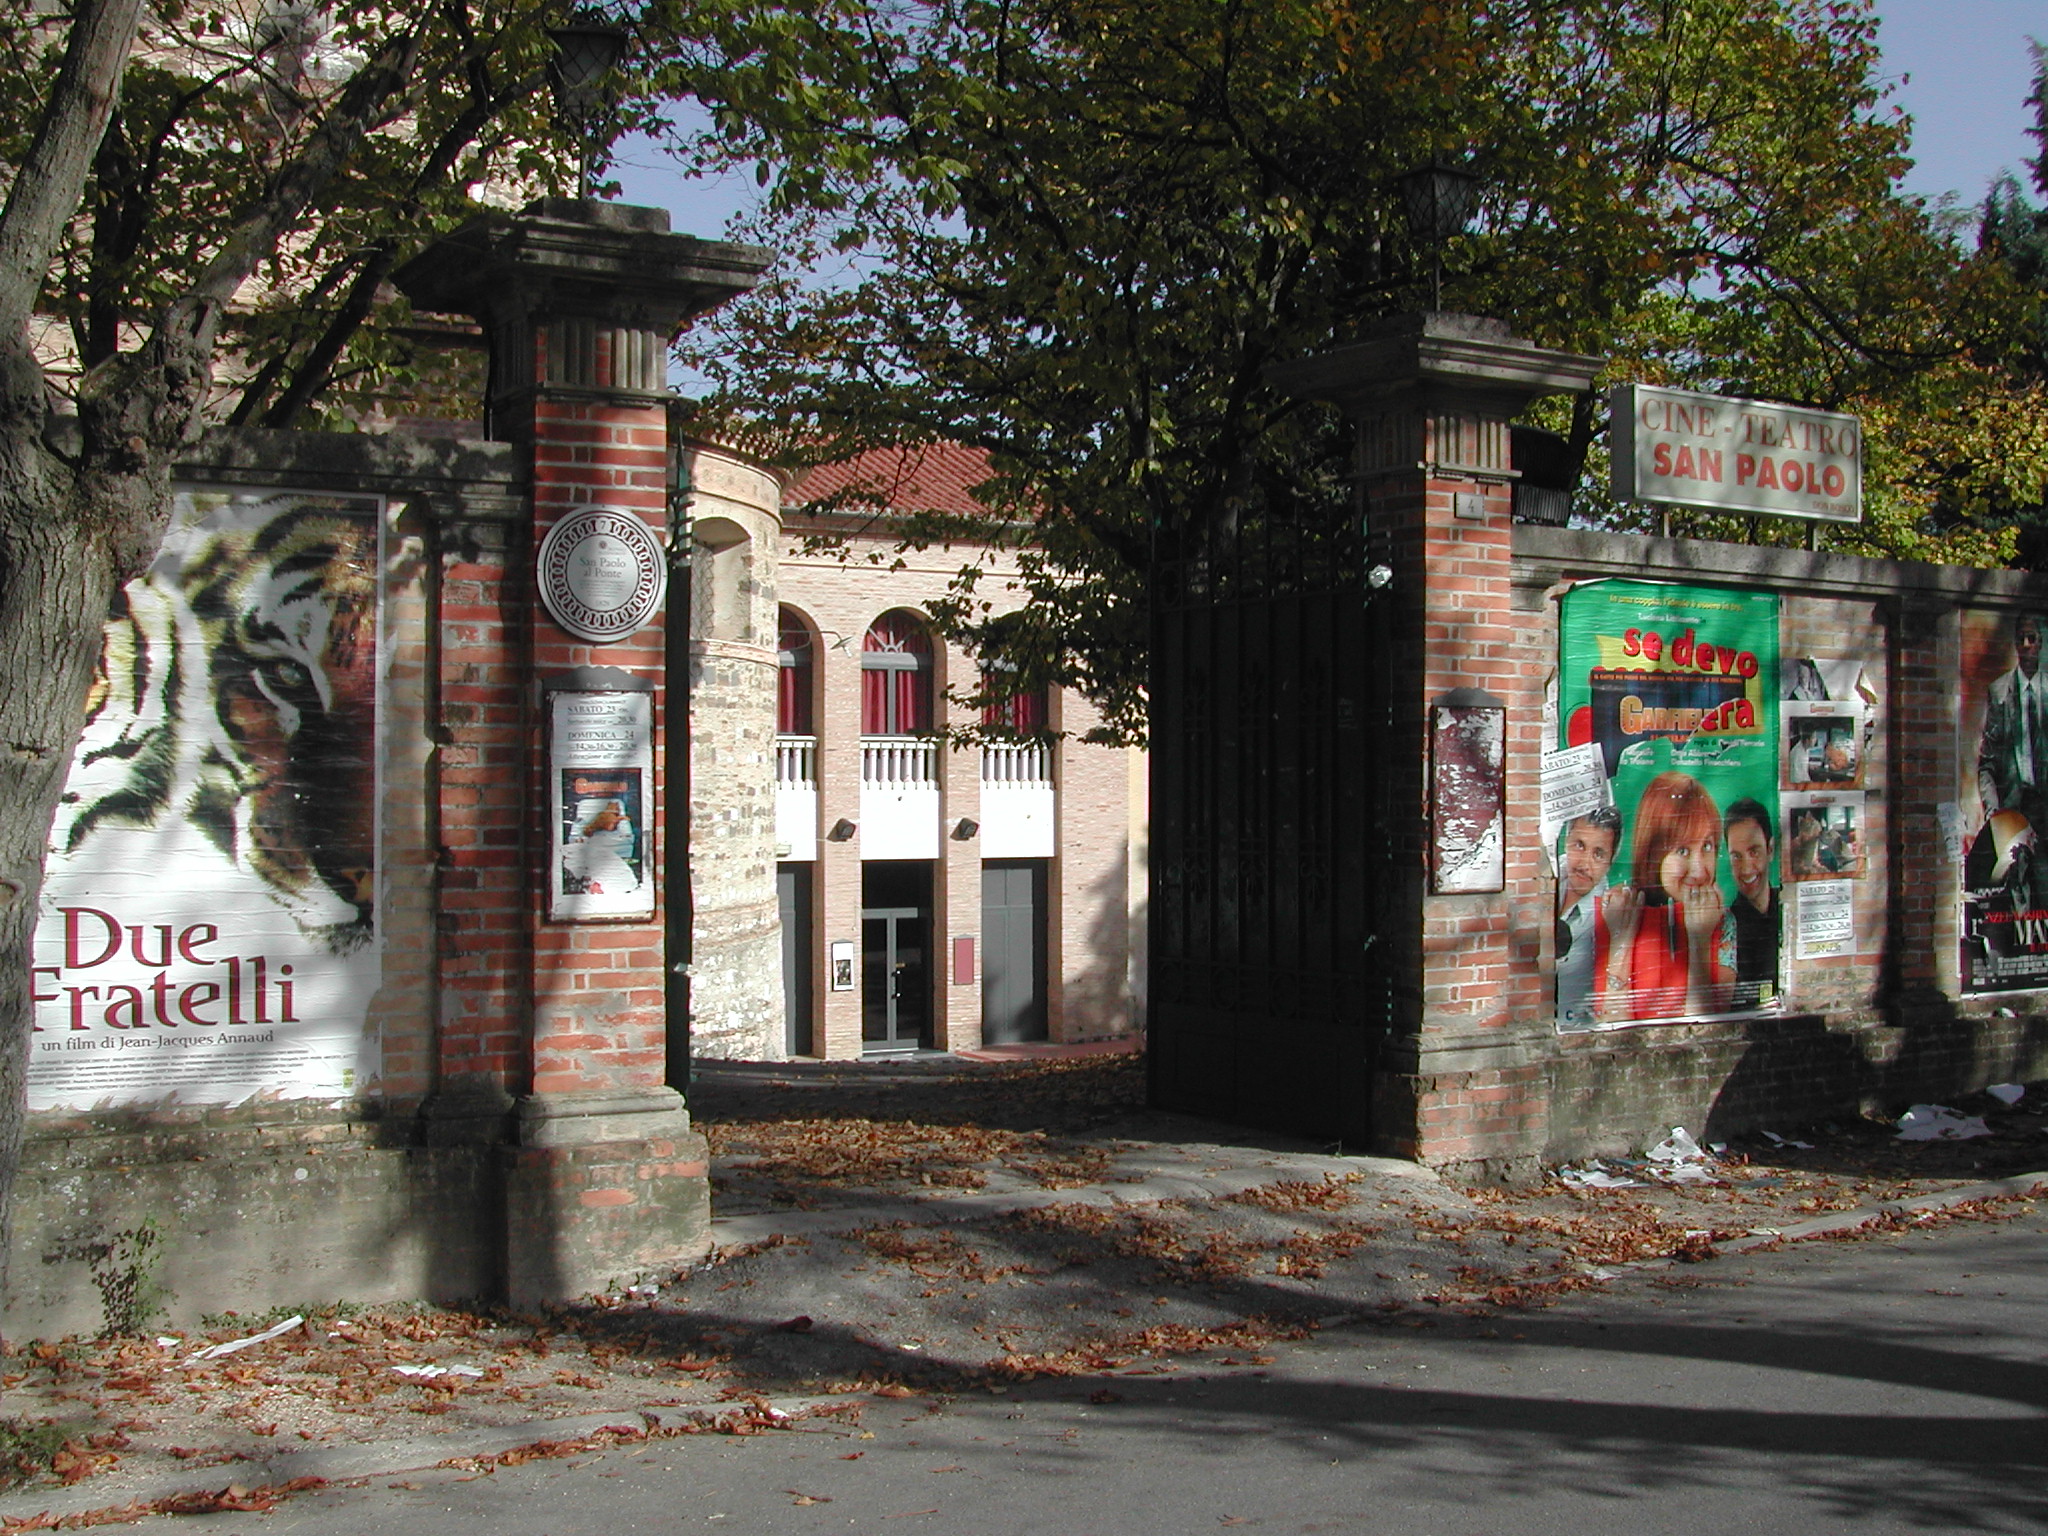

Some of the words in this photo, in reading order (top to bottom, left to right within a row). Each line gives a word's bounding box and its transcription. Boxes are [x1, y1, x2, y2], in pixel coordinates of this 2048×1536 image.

[1641, 398, 1715, 437] CINE
[1740, 412, 1856, 458] TEATRO
[1654, 442, 1723, 483] SAN
[1736, 453, 1845, 497] PAOLO
[600, 520, 607, 530] 7
[580, 557, 597, 567] San
[600, 557, 626, 568] Paolo
[583, 567, 592, 577] al
[595, 567, 623, 578] Ponte
[1671, 627, 1759, 679] devo
[568, 705, 603, 713] SABATO
[568, 731, 616, 739] DOMENICA
[625, 730, 634, 739] 24
[1540, 758, 1570, 771] ABATO
[1543, 782, 1585, 800] DOMENICA
[1592, 777, 1601, 787] 24
[55, 906, 219, 969] Due
[30, 955, 301, 1032] Fratelli
[41, 1041, 61, 1052] un
[66, 1036, 96, 1050] film
[100, 1035, 115, 1049] di
[118, 1033, 214, 1052] Jean-Jacques
[215, 1030, 274, 1044] Annaud
